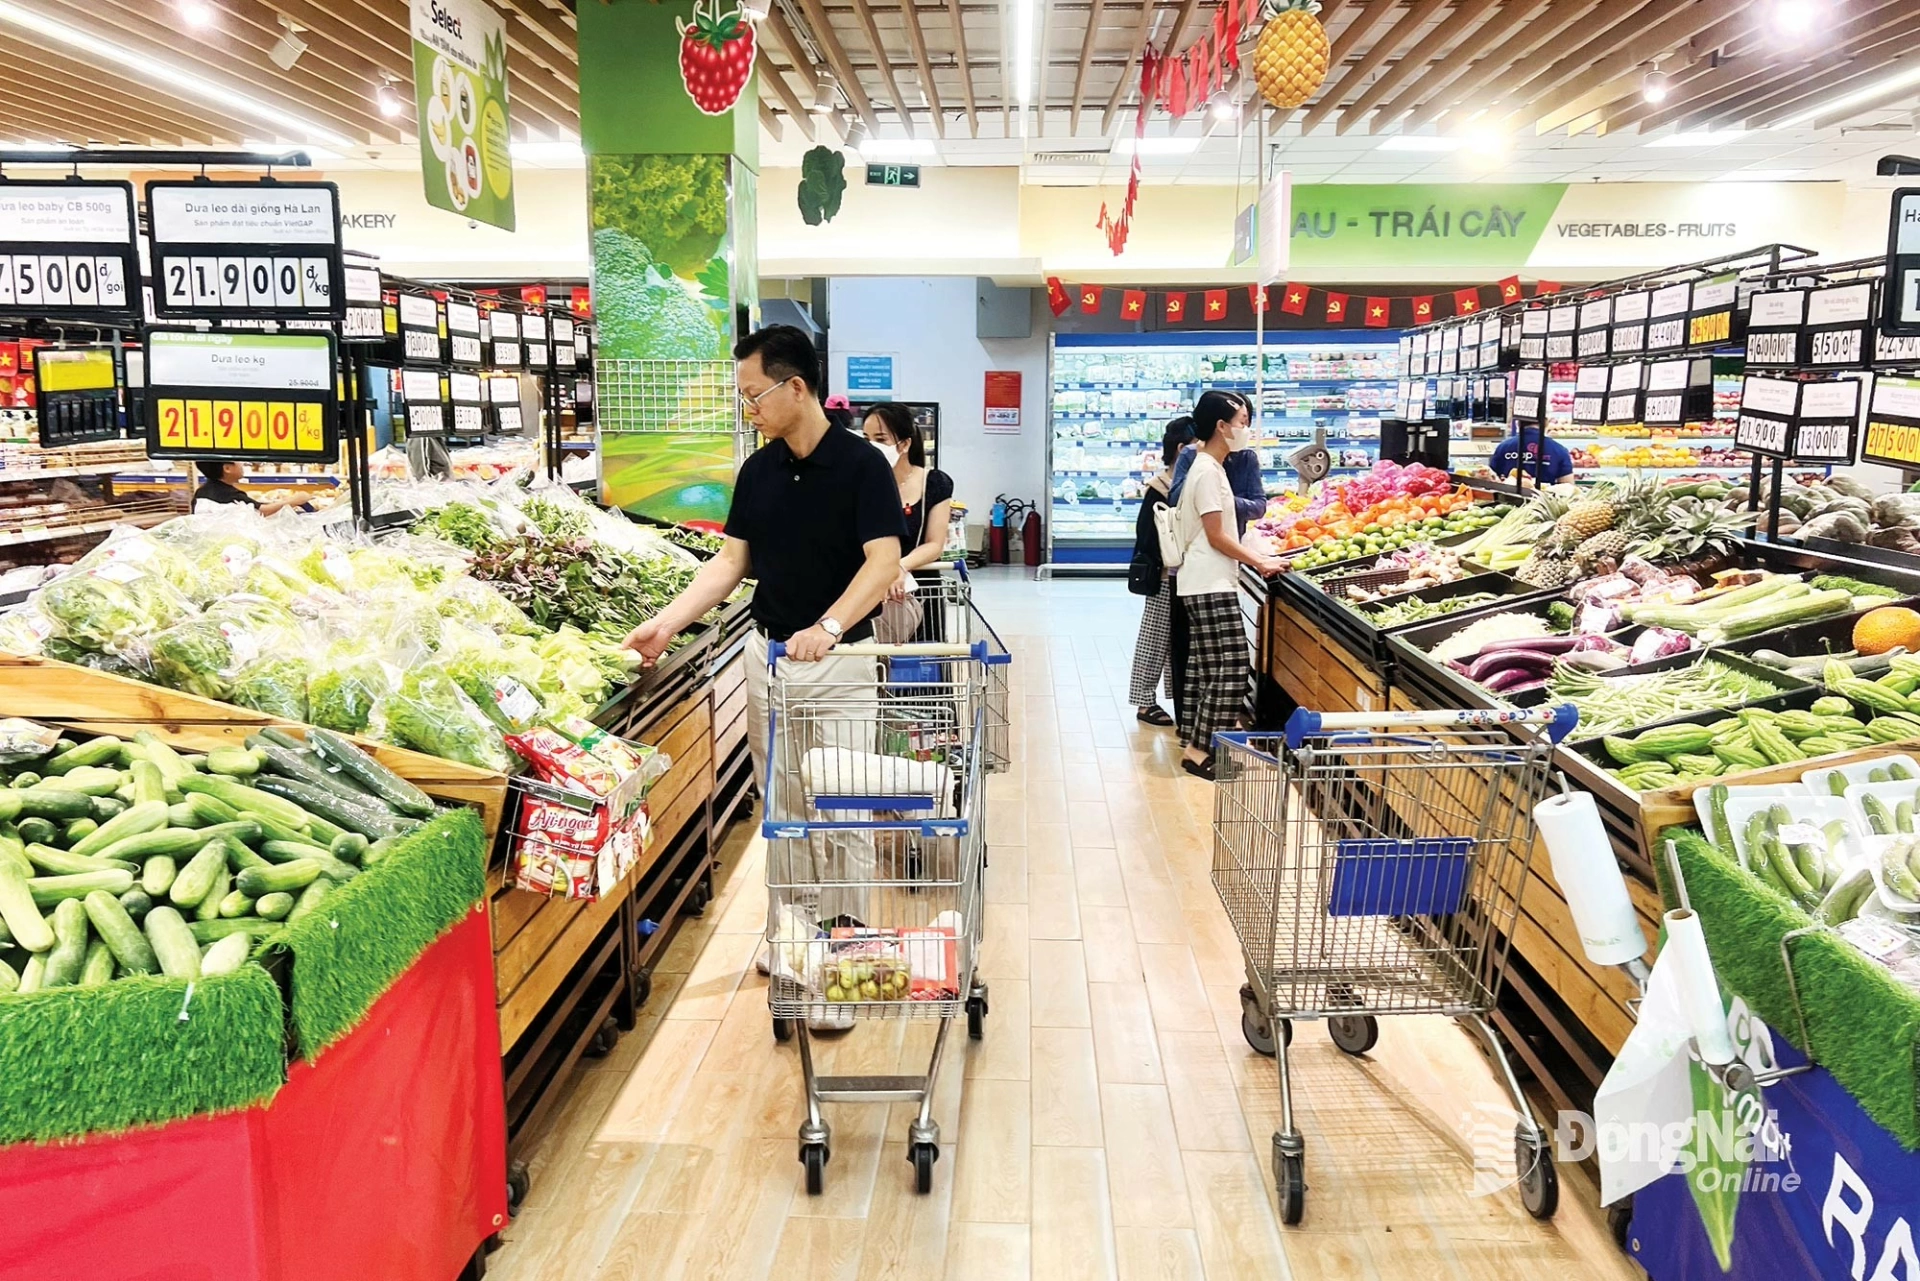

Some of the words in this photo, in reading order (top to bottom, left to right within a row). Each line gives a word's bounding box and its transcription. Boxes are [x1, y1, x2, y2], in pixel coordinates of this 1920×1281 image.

[431, 0, 462, 40] Select
[38, 202, 63, 213] baby
[67, 202, 82, 211] CB
[86, 203, 111, 213] 500g
[211, 203, 228, 213] leo
[301, 204, 321, 213] Lan
[341, 214, 397, 229] AKERY
[1289, 212, 1338, 238] AU
[1368, 205, 1451, 238] TRÁI
[1459, 204, 1526, 238] CÂY
[170, 264, 296, 297] 21.900
[235, 354, 251, 363] leo
[253, 354, 265, 366] kg
[165, 407, 289, 440] 21.900
